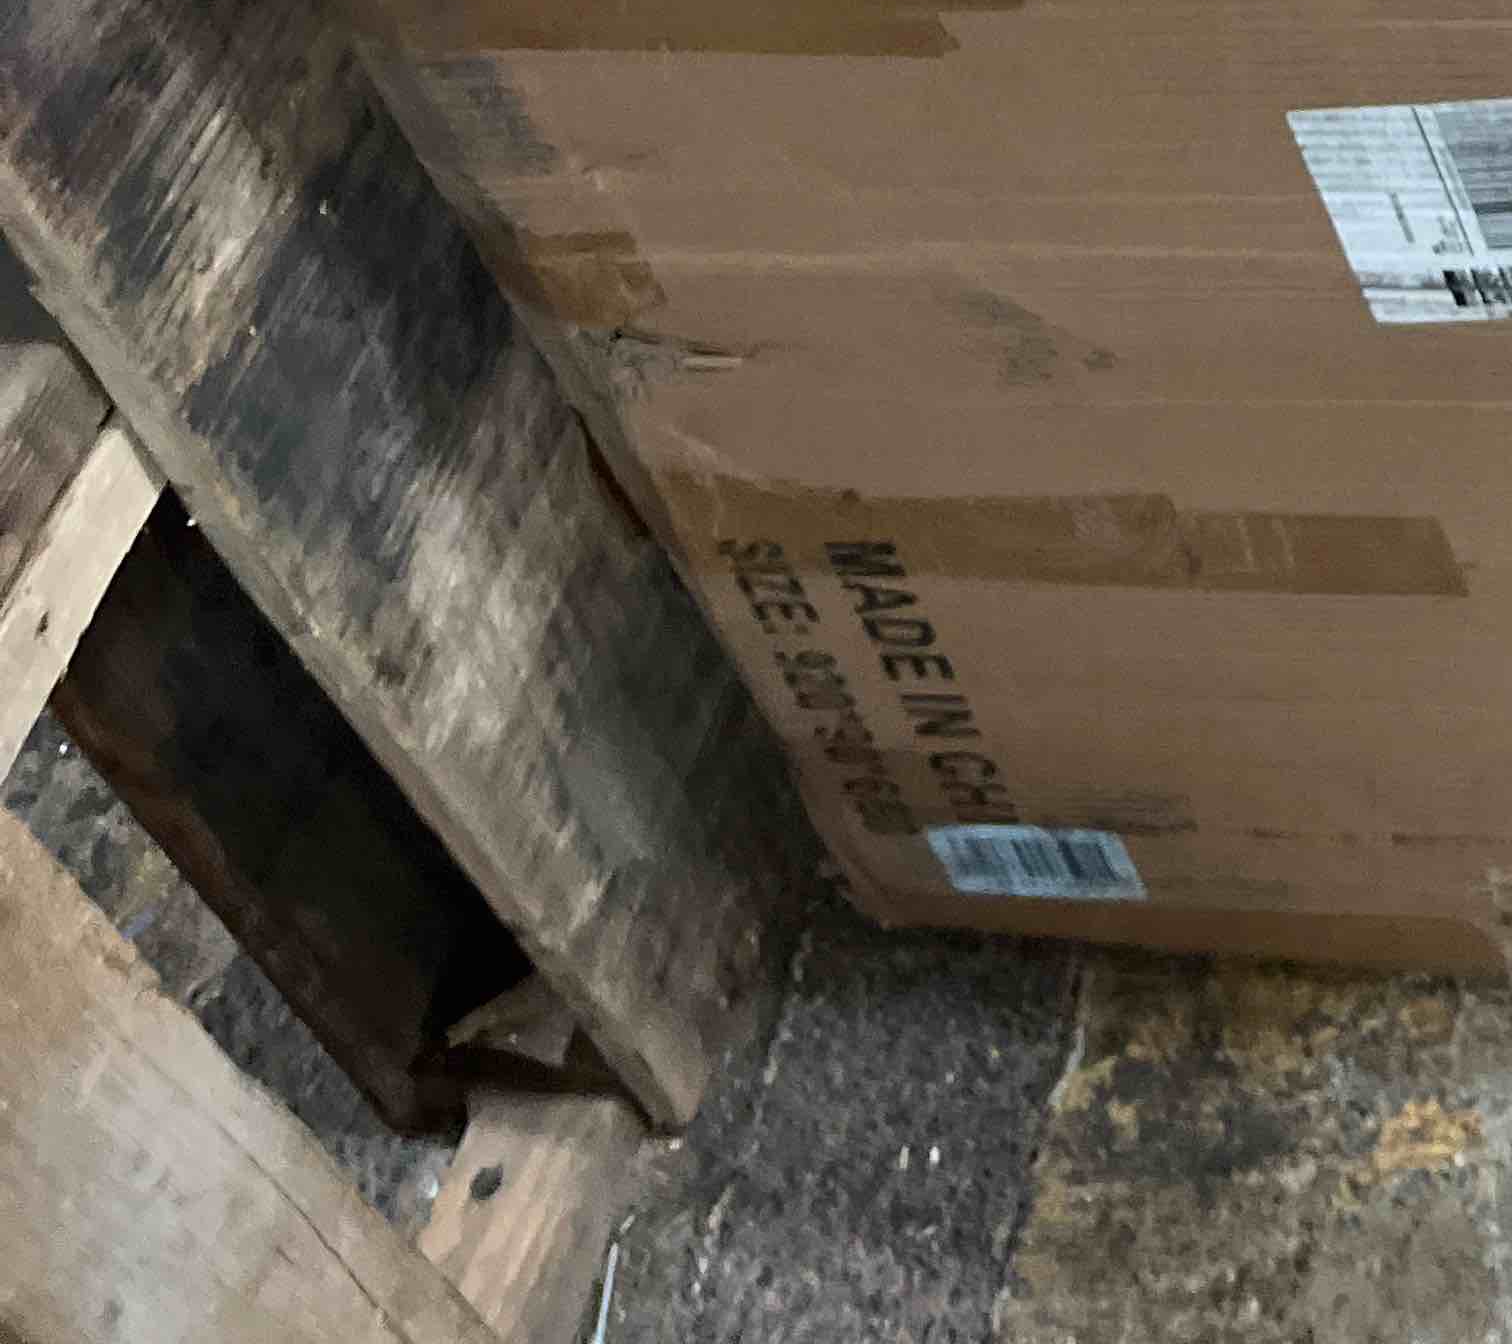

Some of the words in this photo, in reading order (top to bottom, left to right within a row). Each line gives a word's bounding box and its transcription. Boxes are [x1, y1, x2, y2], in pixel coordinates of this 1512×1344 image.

[824, 541, 955, 681] MADE
[901, 694, 982, 738] IN
[929, 751, 1020, 824] CHI
